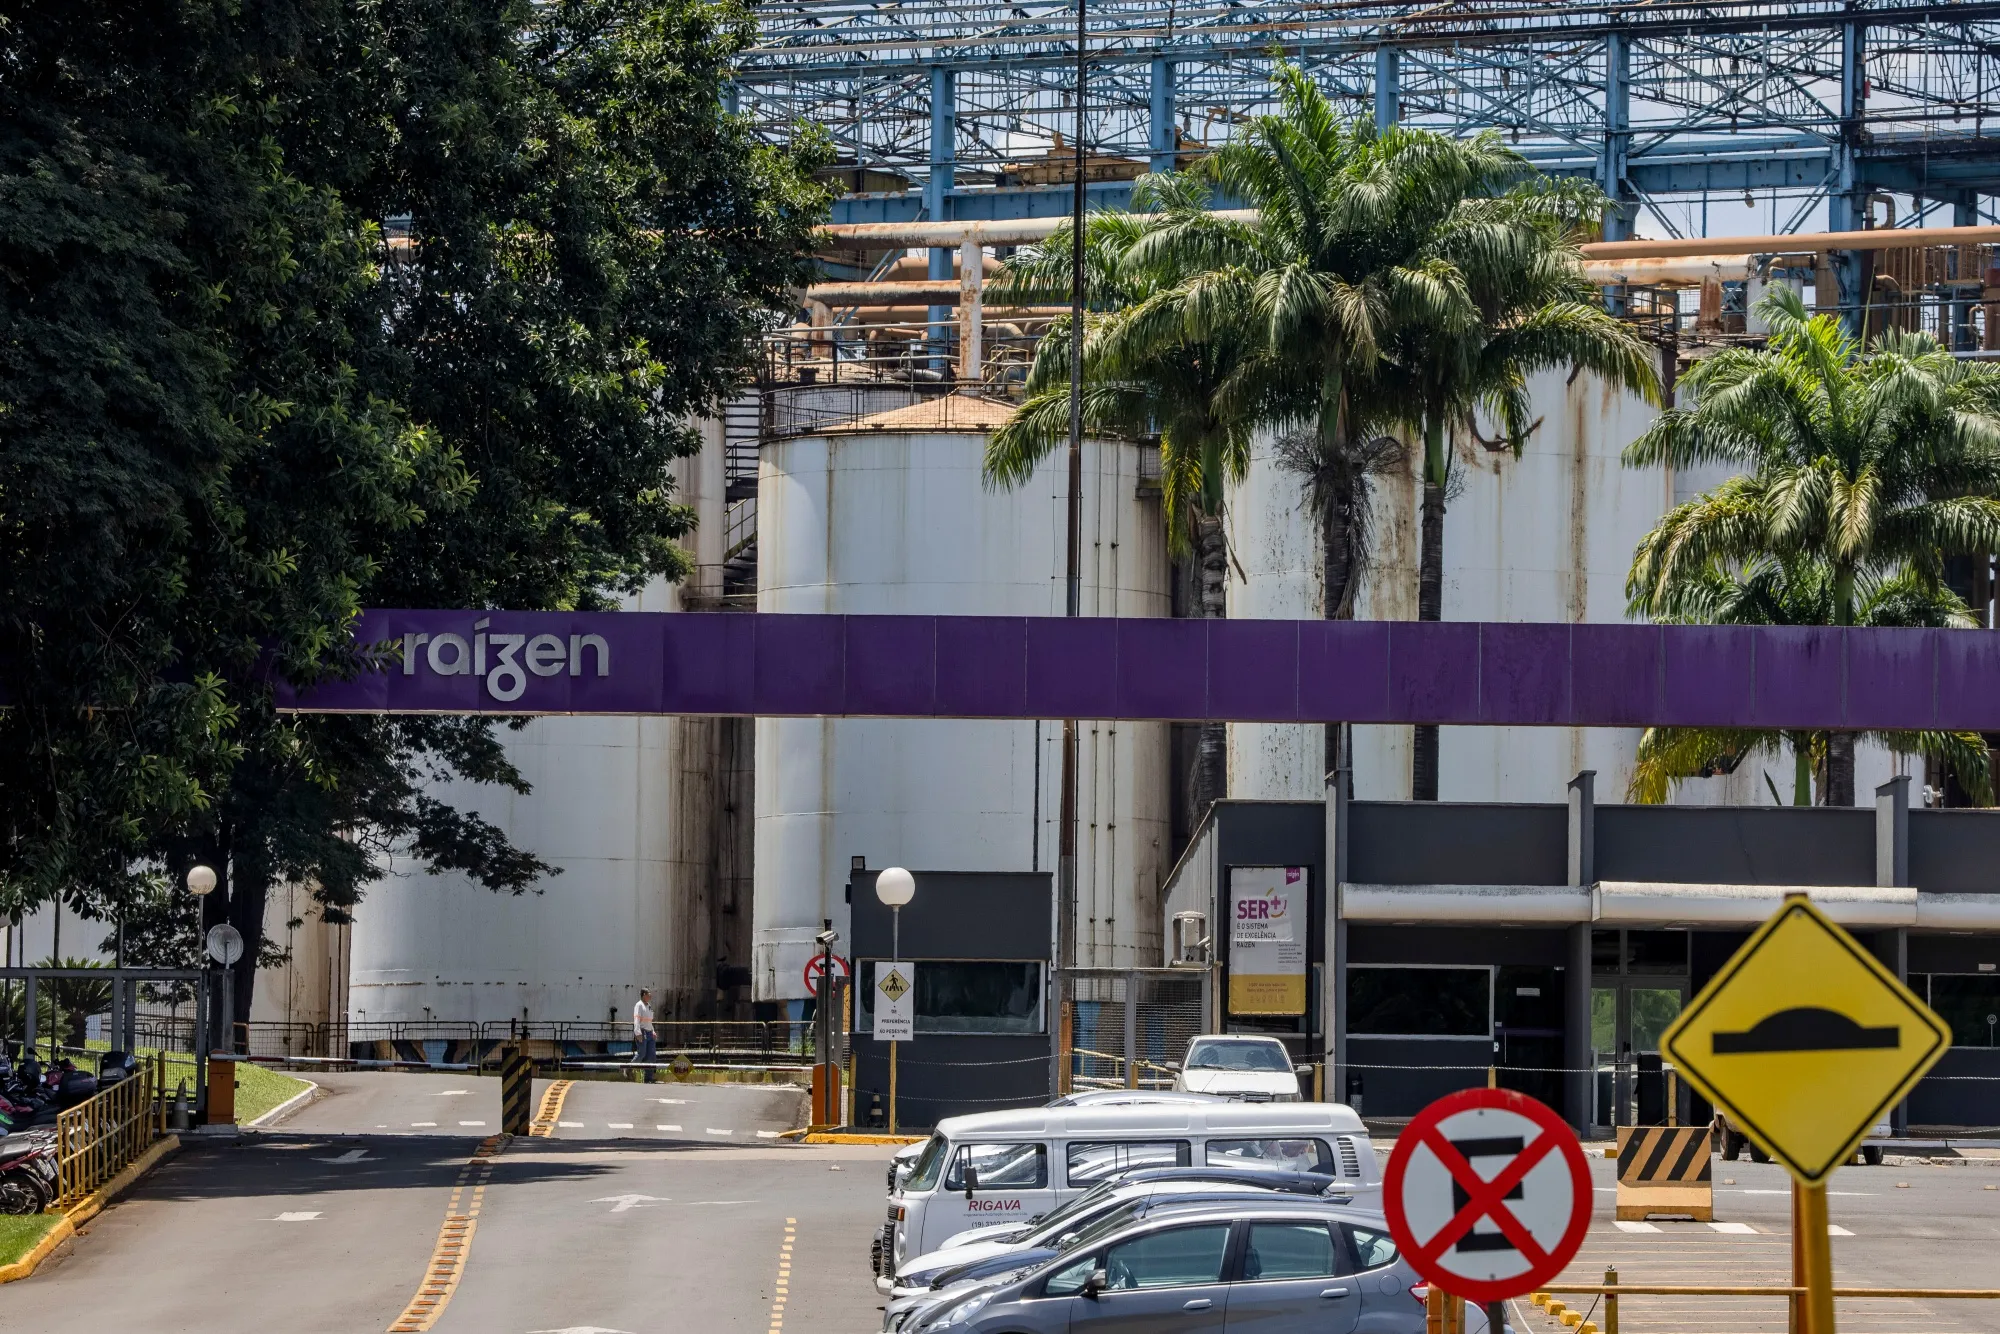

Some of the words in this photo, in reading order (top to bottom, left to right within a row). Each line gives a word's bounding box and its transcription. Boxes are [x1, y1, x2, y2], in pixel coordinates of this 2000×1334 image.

[403, 616, 610, 702] raízen
[1245, 931, 1277, 939] EXCELÊNCIA
[968, 1199, 1021, 1211] RIGAVA
[971, 1221, 984, 1229] (19)
